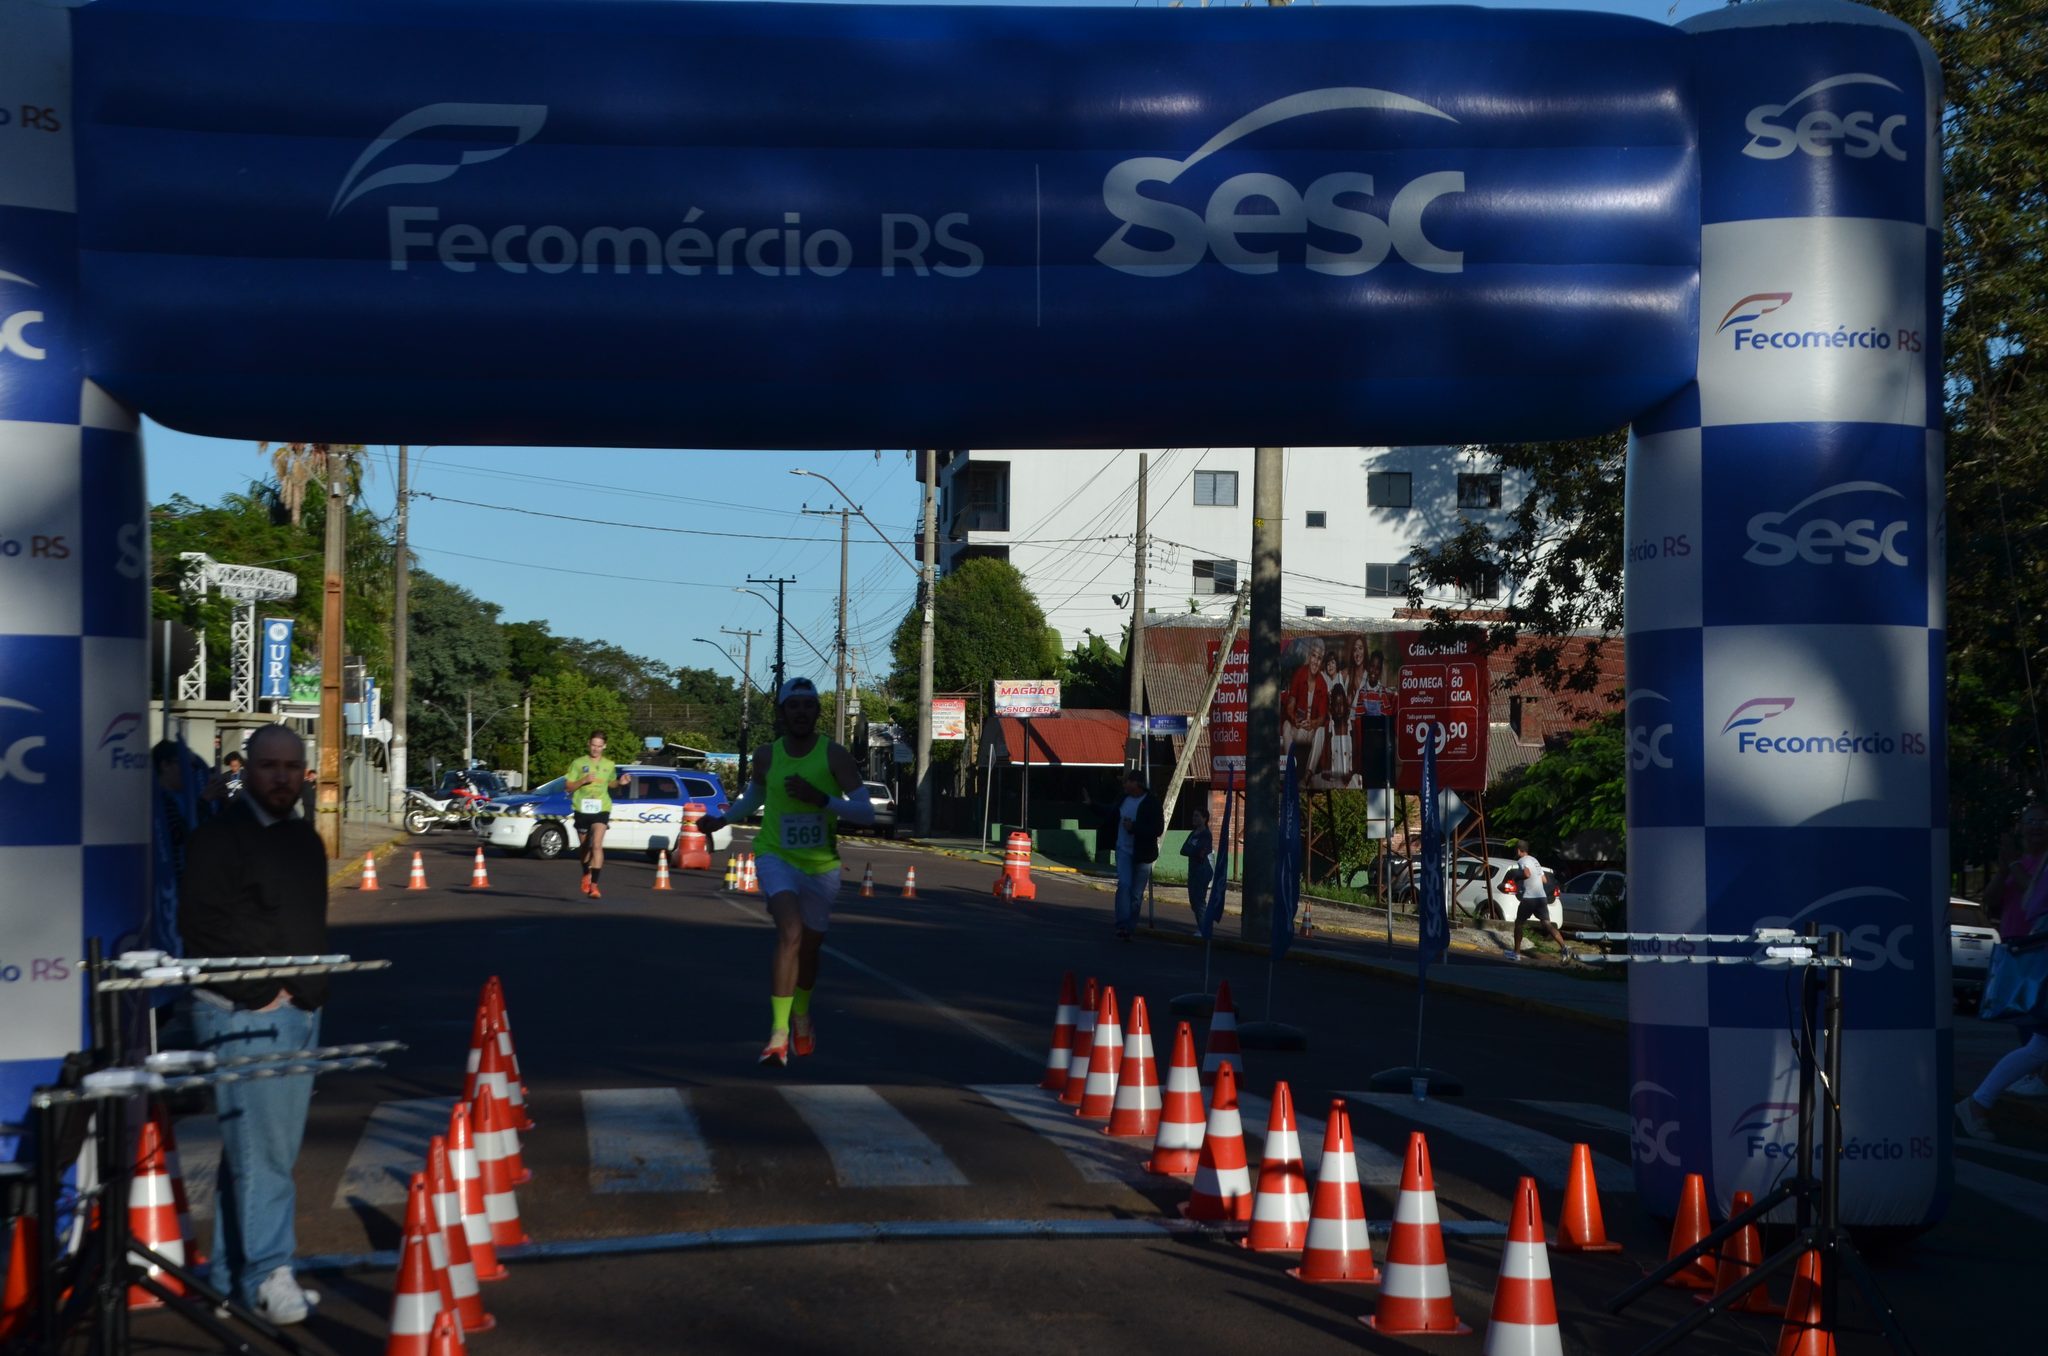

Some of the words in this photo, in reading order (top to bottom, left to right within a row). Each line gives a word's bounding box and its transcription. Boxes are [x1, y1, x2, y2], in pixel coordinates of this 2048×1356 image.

[21, 106, 61, 132] RS
[1093, 87, 1466, 278] Sesc
[387, 206, 853, 278] Fecomércio
[881, 212, 985, 278] RS
[1735, 325, 1891, 350] Fecomércio
[1898, 329, 1921, 353] RS
[31, 535, 70, 560] RS
[1664, 534, 1691, 558] RS
[268, 644, 288, 695] URI
[1402, 677, 1418, 689] 600
[1419, 677, 1443, 688] MEGA
[1451, 676, 1463, 688] 60
[1450, 691, 1472, 702] GIGA
[1222, 711, 1233, 723] na
[1213, 727, 1242, 743] cidade.
[1406, 724, 1414, 735] R$
[1628, 722, 1674, 770] sc
[1739, 731, 1895, 754] Fecomércio
[1902, 733, 1926, 755] RS
[787, 826, 821, 845] 569
[32, 956, 70, 982] RS
[1747, 1135, 1904, 1160] Fecércio
[1911, 1137, 1933, 1159] RS
